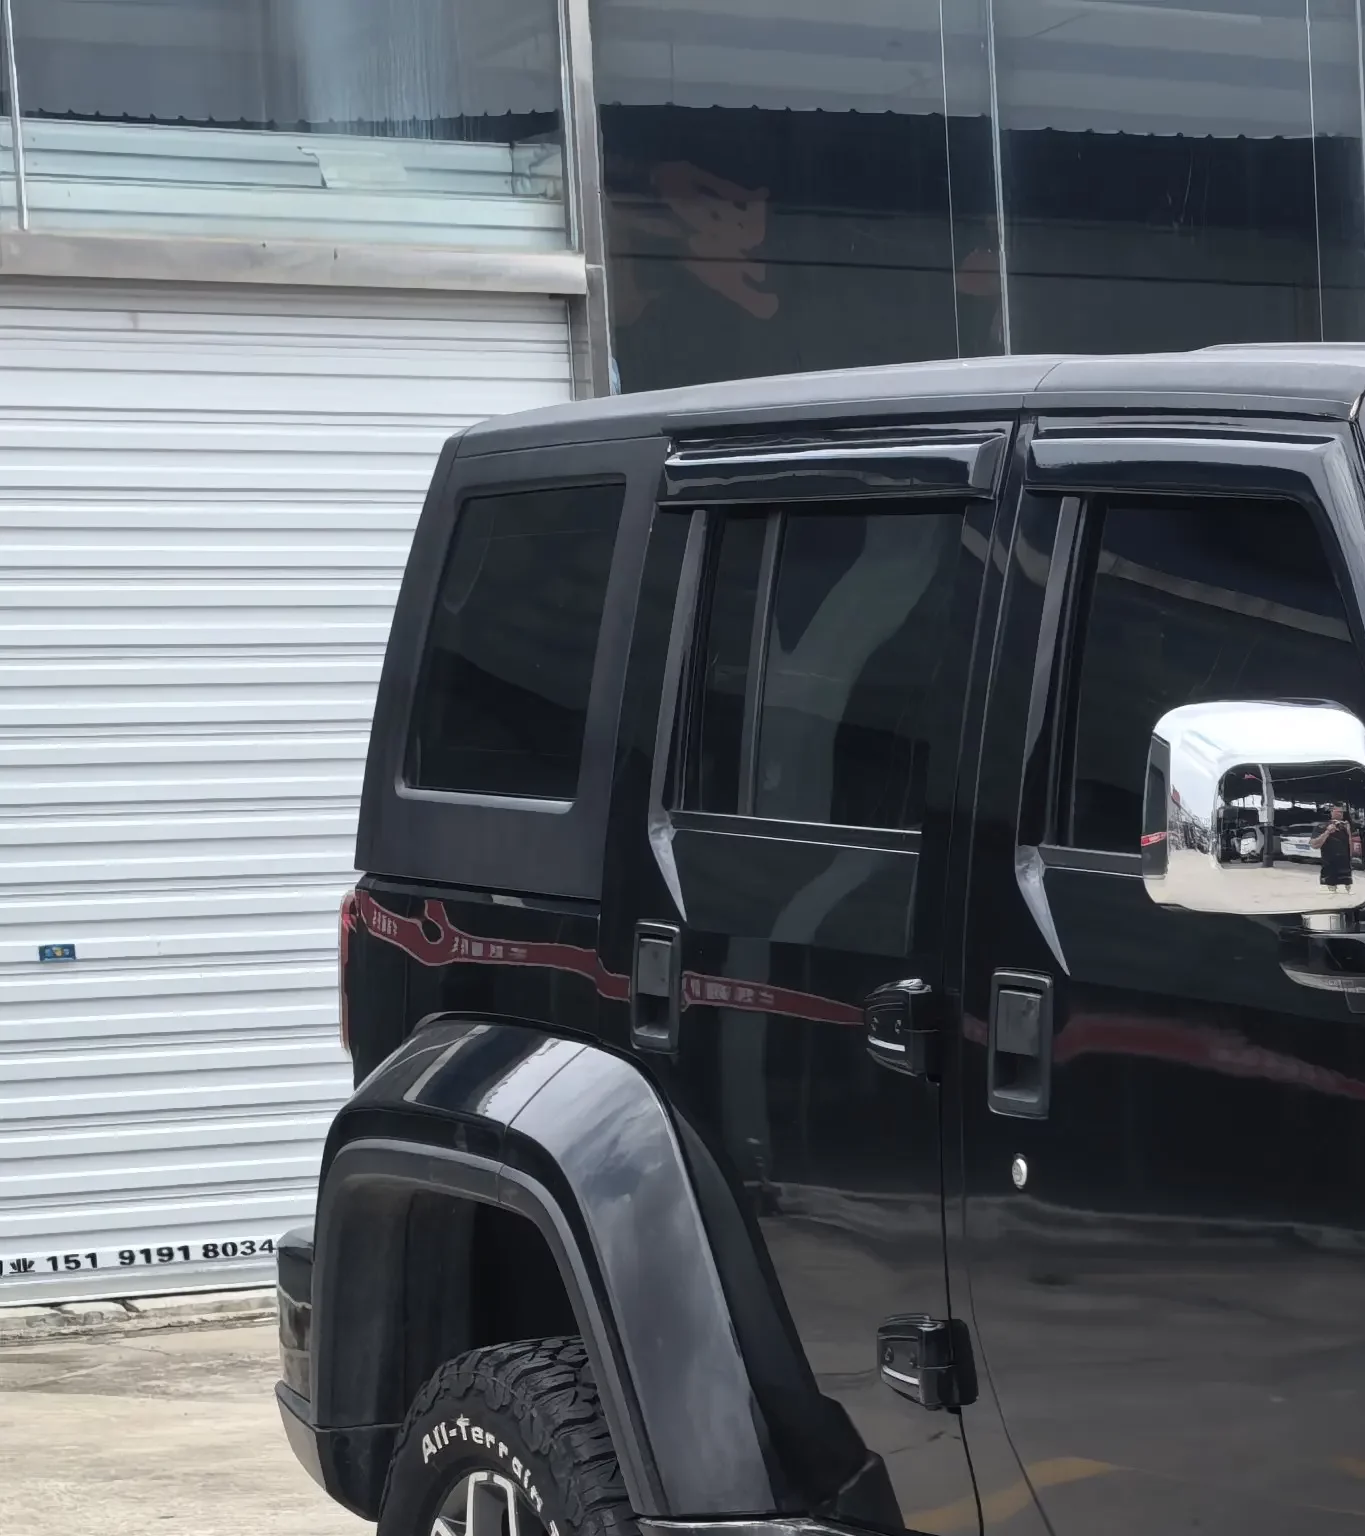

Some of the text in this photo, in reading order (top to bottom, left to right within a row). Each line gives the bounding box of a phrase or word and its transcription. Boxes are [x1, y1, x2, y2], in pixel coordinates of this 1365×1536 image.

[46, 1252, 98, 1272] 151
[118, 1245, 190, 1267] 9191
[202, 1238, 276, 1260] 8034
[422, 1413, 544, 1512] All-Terrain
